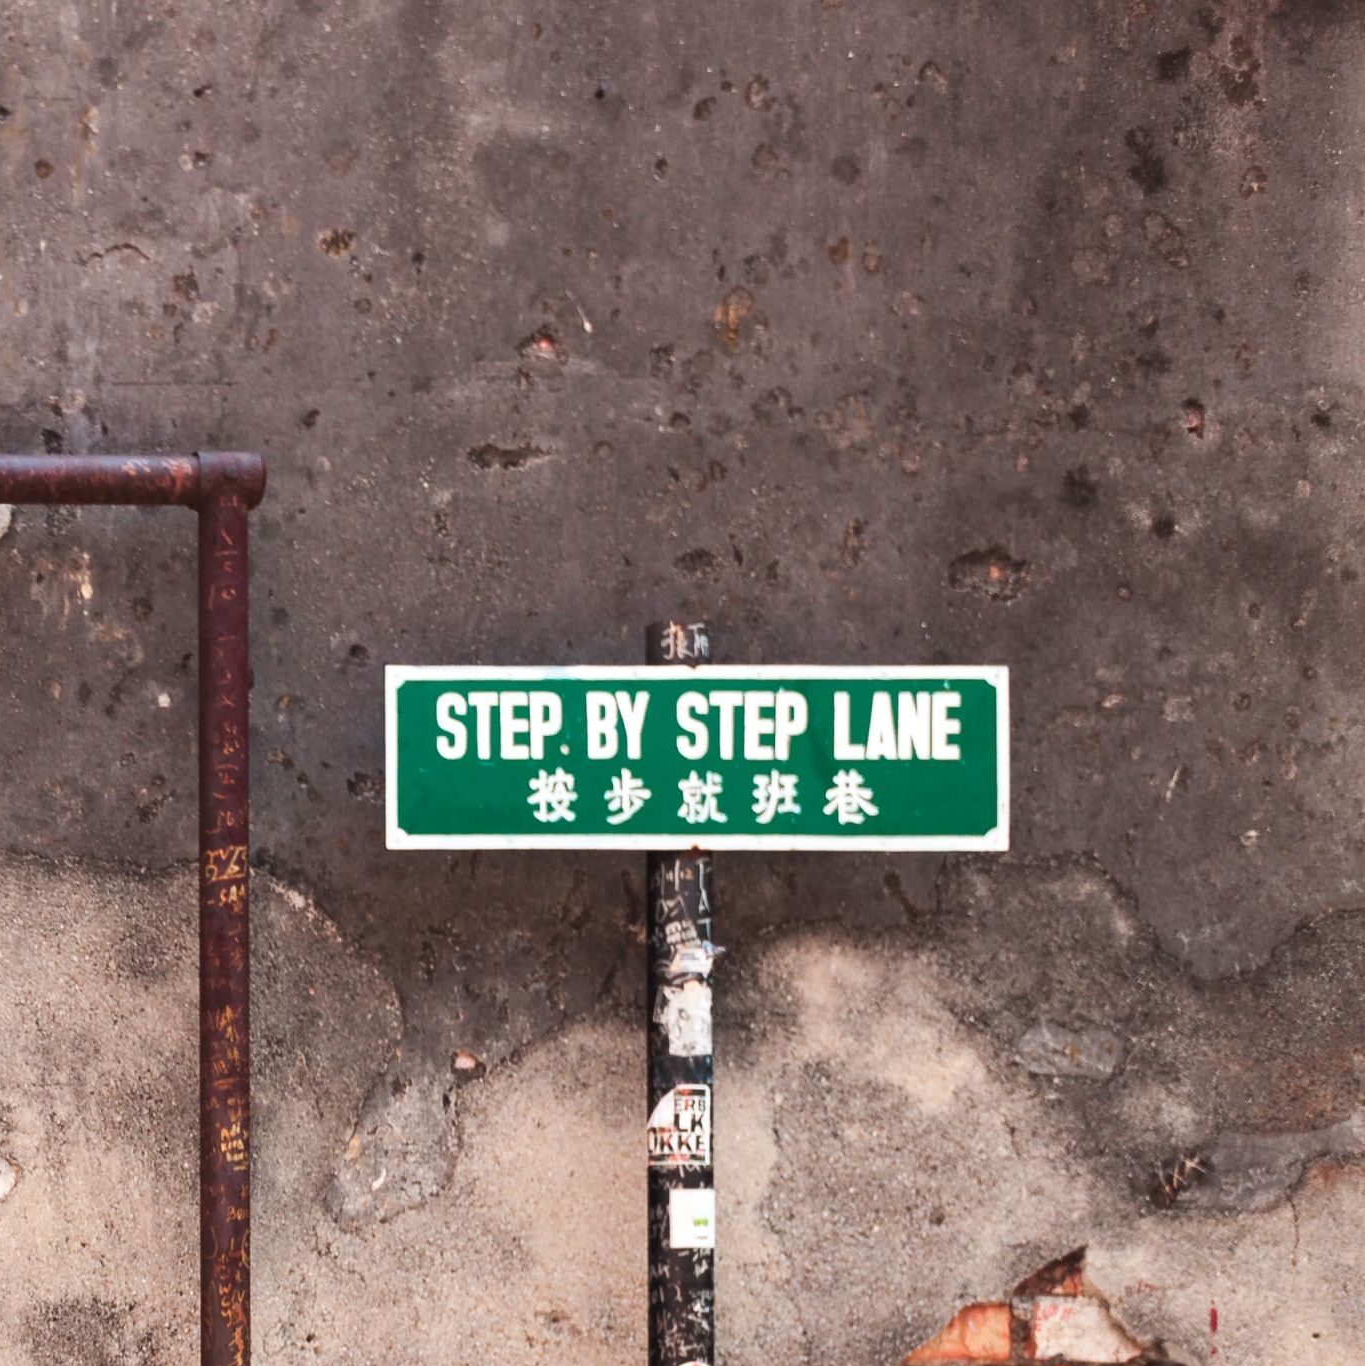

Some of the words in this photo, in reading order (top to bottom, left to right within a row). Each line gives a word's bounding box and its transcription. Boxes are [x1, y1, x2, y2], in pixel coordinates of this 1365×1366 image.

[436, 690, 562, 760] STEP
[585, 690, 649, 760] BY
[676, 690, 807, 760] STEP
[833, 690, 960, 760] LANE
[527, 767, 877, 825] 按步就班巷
